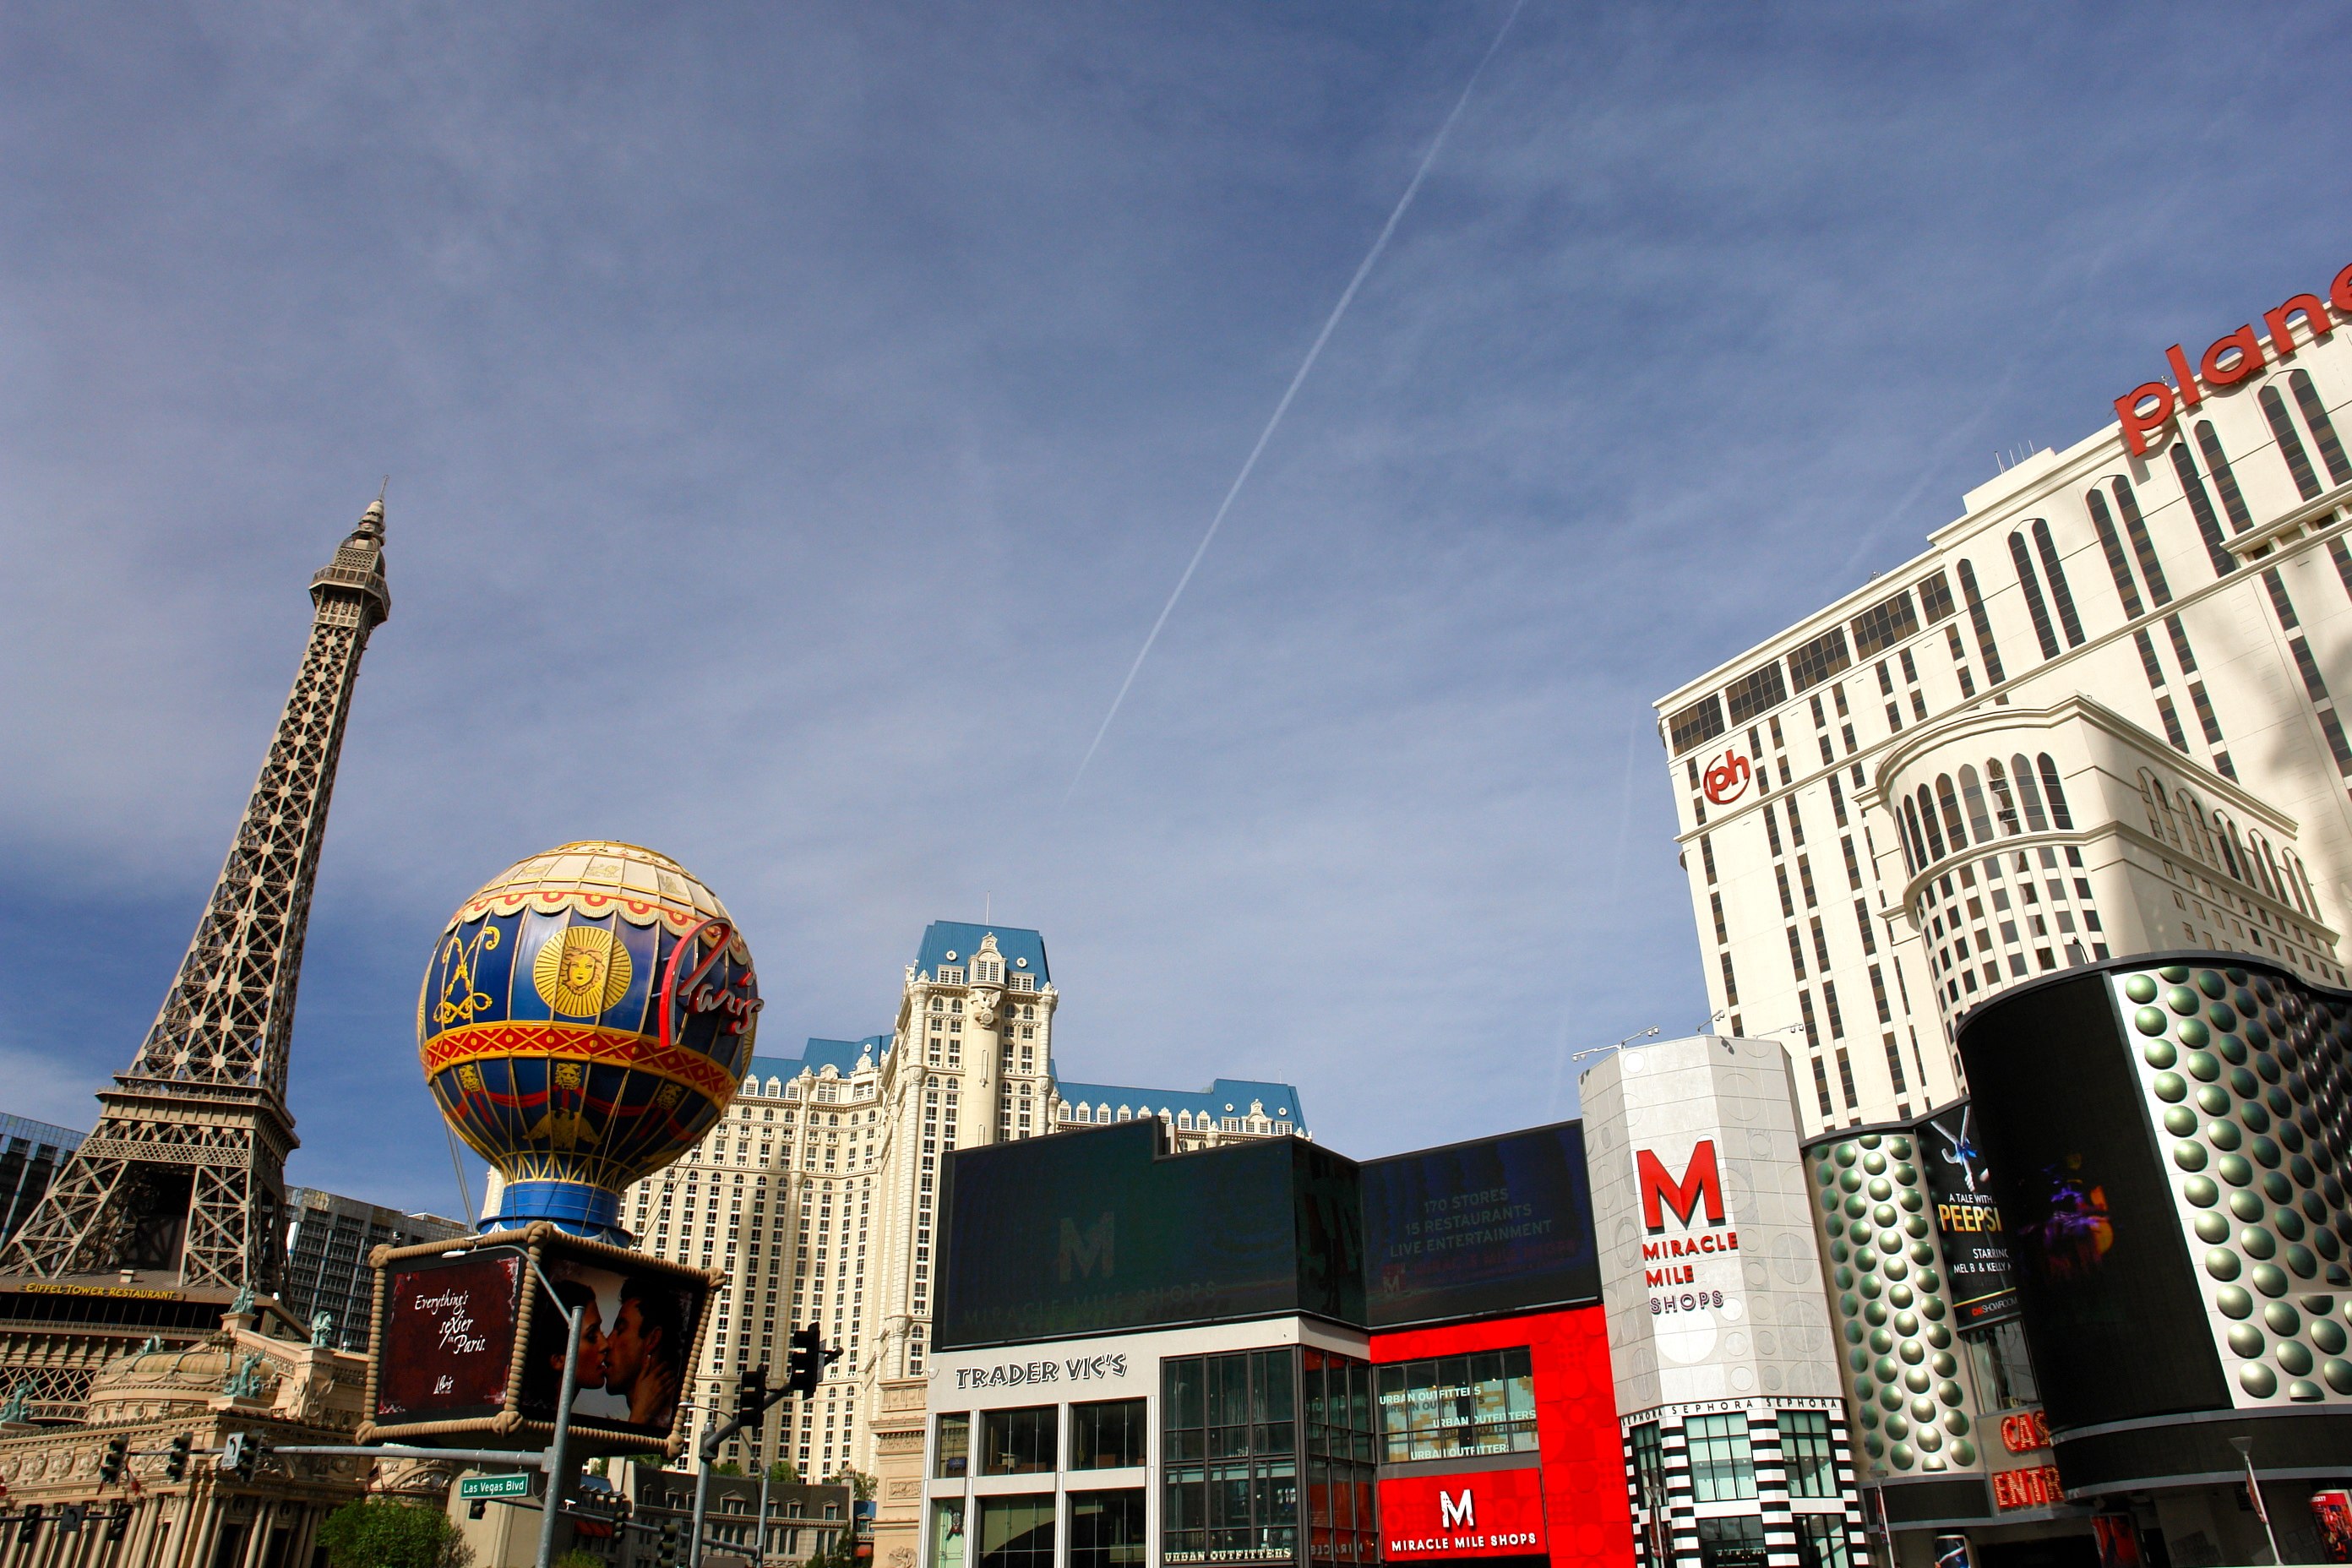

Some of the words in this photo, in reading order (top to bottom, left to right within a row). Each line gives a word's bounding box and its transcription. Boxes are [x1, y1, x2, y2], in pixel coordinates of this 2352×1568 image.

[659, 917, 765, 1048] Paris
[1636, 1139, 1726, 1233] M
[1424, 1200, 1447, 1214] 170
[1452, 1188, 1509, 1209] STORES
[1949, 1193, 1956, 1203] A
[1957, 1193, 1974, 1204] TALE
[1974, 1194, 1993, 1205] WITH
[1406, 1222, 1420, 1236] 15
[1424, 1203, 1532, 1233] RESTAURANTS
[1390, 1240, 1421, 1258] LIVE
[1427, 1219, 1553, 1253] ENTERTAINMENT
[1642, 1232, 1739, 1261] MIRACLE
[1646, 1265, 1695, 1288] MILE
[1953, 1263, 1969, 1274] MEL
[1970, 1263, 1975, 1273] B
[25, 1282, 63, 1294] EIFFEL
[66, 1284, 105, 1297] TOWER
[109, 1287, 176, 1301] RESTAURANT
[414, 1288, 469, 1315] Everything's
[1651, 1289, 1724, 1315] SHOPS
[956, 1360, 1059, 1390] TRADER
[1064, 1352, 1128, 1380] VIC'S
[1379, 1392, 1415, 1405] URBAN
[1671, 1399, 1753, 1415] SEPHORA
[1767, 1397, 1838, 1408] SEPHORA
[1433, 1416, 1469, 1429] URBAN
[1620, 1408, 1663, 1426] SEPHORA
[463, 1483, 478, 1494] Las
[480, 1482, 504, 1495] Vegas
[506, 1480, 525, 1492] Blvd
[1440, 1489, 1475, 1528] M
[1391, 1538, 1449, 1552] MIRACLE
[1454, 1535, 1484, 1549] MILE
[1490, 1532, 1537, 1547] SHOPS
[1164, 1551, 1206, 1562] URBAN
[1210, 1548, 1292, 1561] OUTFITTERS
